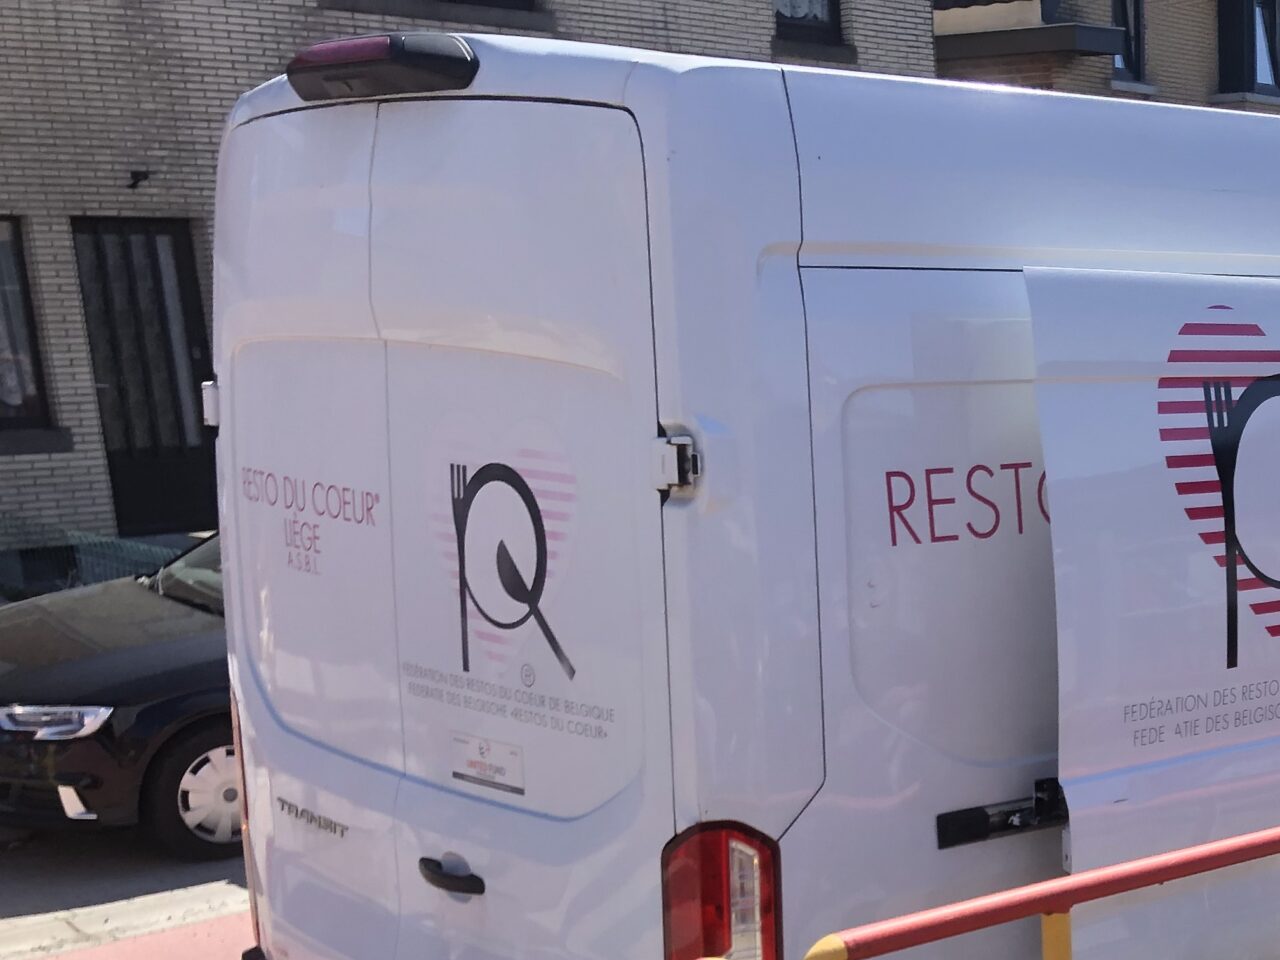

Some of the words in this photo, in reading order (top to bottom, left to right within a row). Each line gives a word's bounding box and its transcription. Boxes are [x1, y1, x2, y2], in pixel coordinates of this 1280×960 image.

[283, 475, 306, 512] DU
[885, 461, 1051, 547] REST
[466, 677, 497, 697] RESTOS
[499, 685, 512, 700] DU
[513, 689, 546, 708] COEUR
[548, 696, 561, 712] DE
[564, 699, 615, 723] BELGIQUE
[1213, 687, 1237, 707] DES
[550, 716, 564, 732] DU
[1206, 713, 1229, 734] DES
